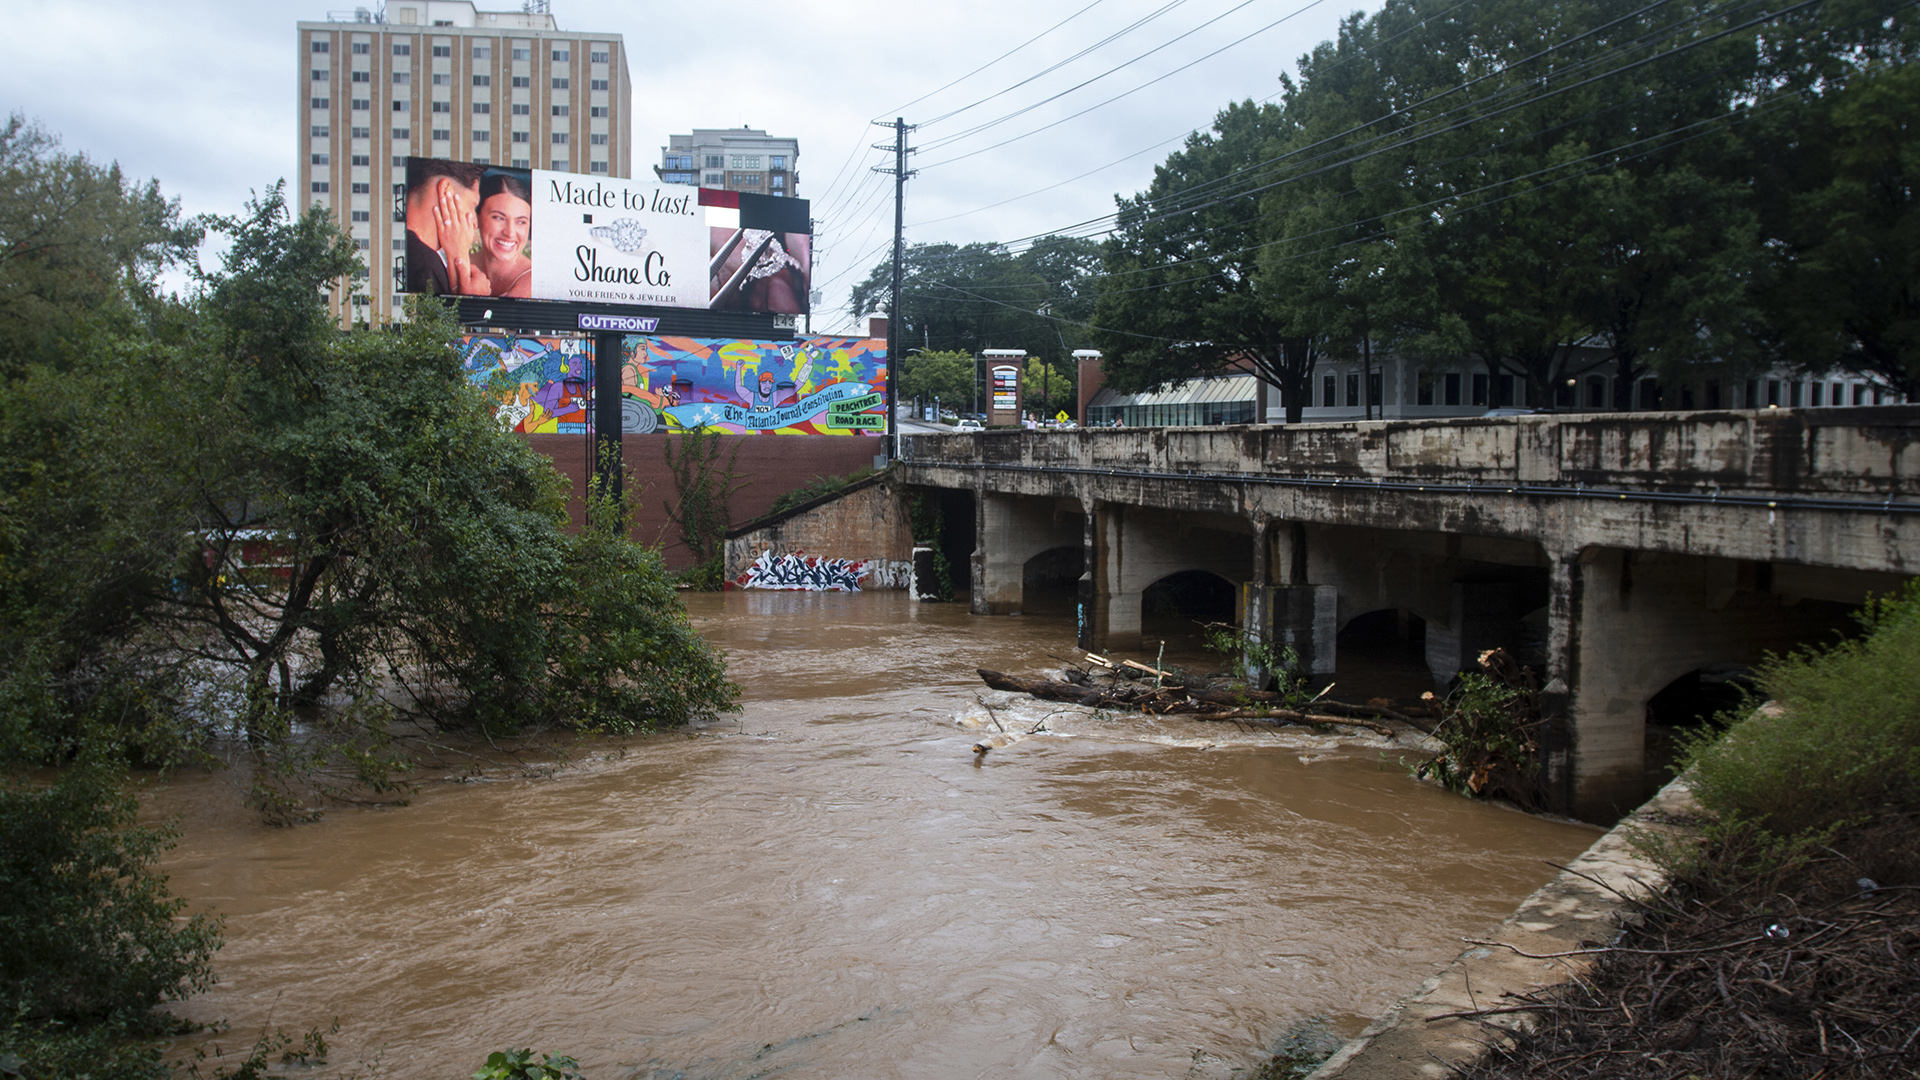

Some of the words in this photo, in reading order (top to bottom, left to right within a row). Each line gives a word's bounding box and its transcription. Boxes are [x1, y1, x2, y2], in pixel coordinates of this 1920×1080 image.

[549, 179, 616, 208] Made
[622, 188, 645, 211] to
[651, 188, 695, 216] last.
[574, 245, 642, 285] Shane
[644, 251, 671, 287] Co.
[568, 289, 593, 298] YOUR
[595, 291, 627, 300] FRIEND
[636, 294, 677, 303] JEWELER
[581, 316, 655, 330] OUTFRONT
[836, 395, 877, 411] PEACHTREE
[724, 405, 743, 420] The
[748, 415, 776, 428] Atlanta
[835, 416, 855, 425] ROAD
[856, 417, 877, 426] RACE
